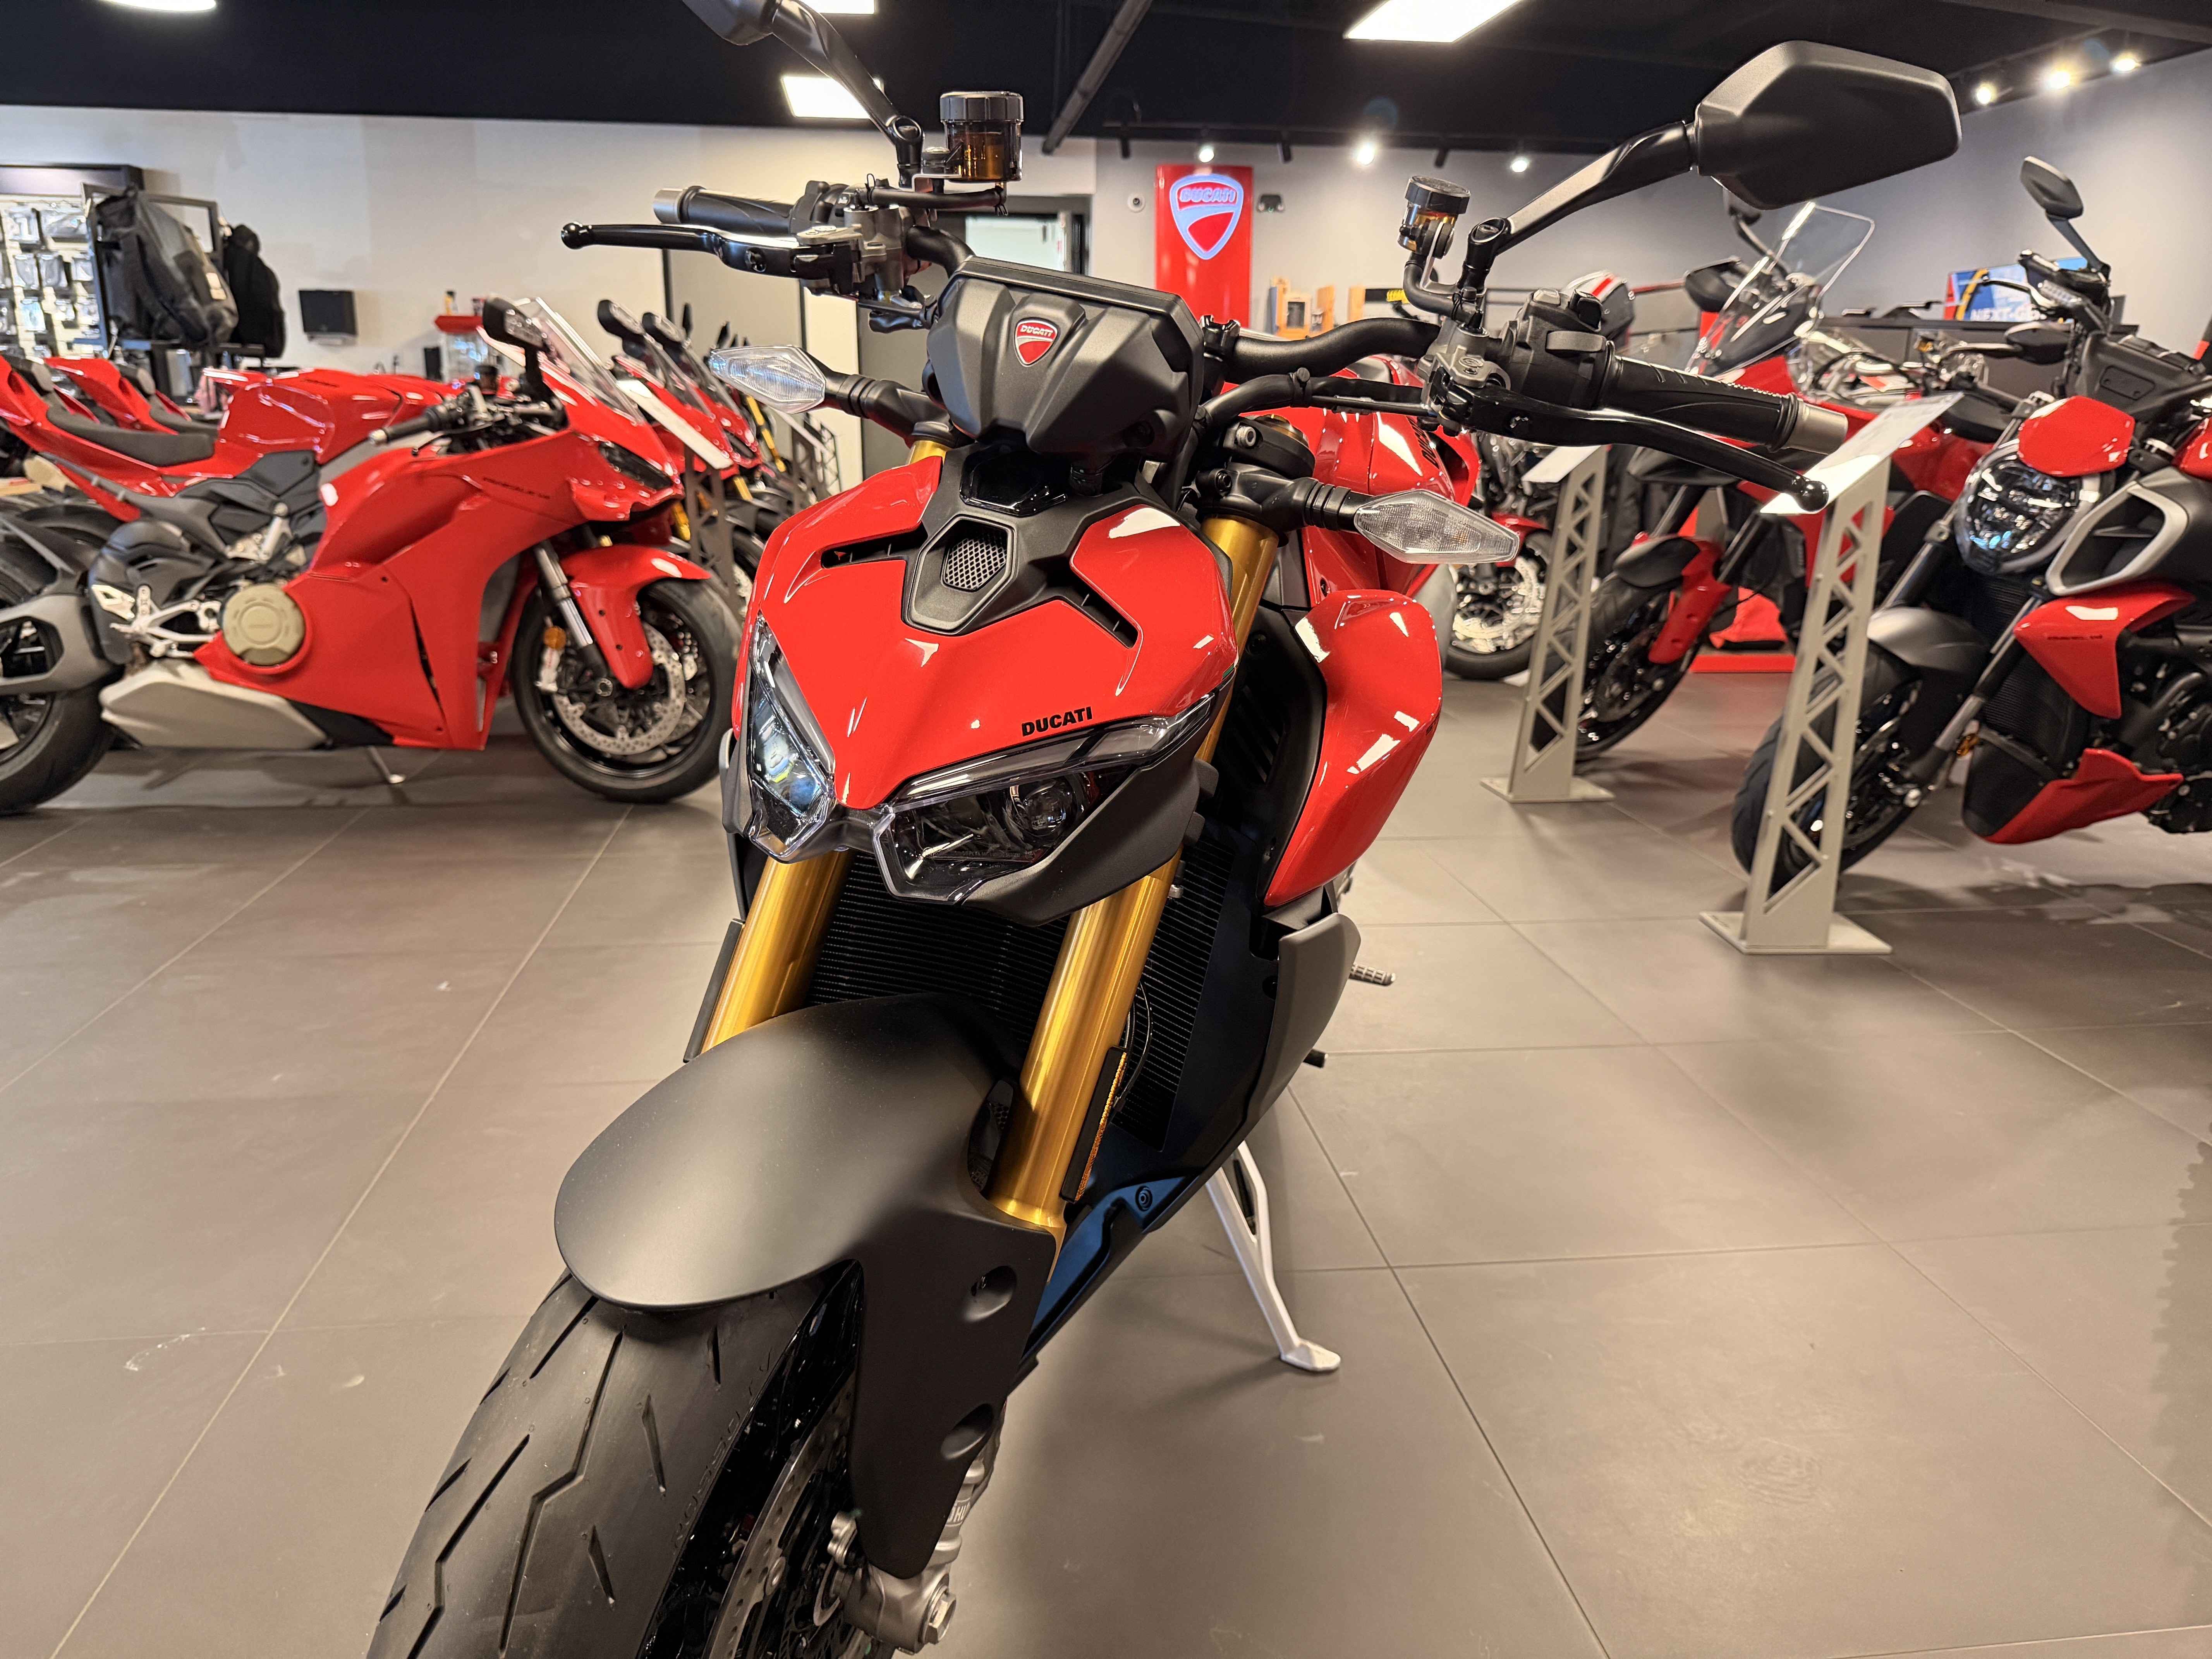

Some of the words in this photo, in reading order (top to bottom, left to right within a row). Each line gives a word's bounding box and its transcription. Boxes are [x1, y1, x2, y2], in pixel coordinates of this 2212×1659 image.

[1180, 187, 1236, 203] DUCATI
[1020, 325, 1053, 337] DUCATI
[1021, 706, 1092, 737] DUCATI
